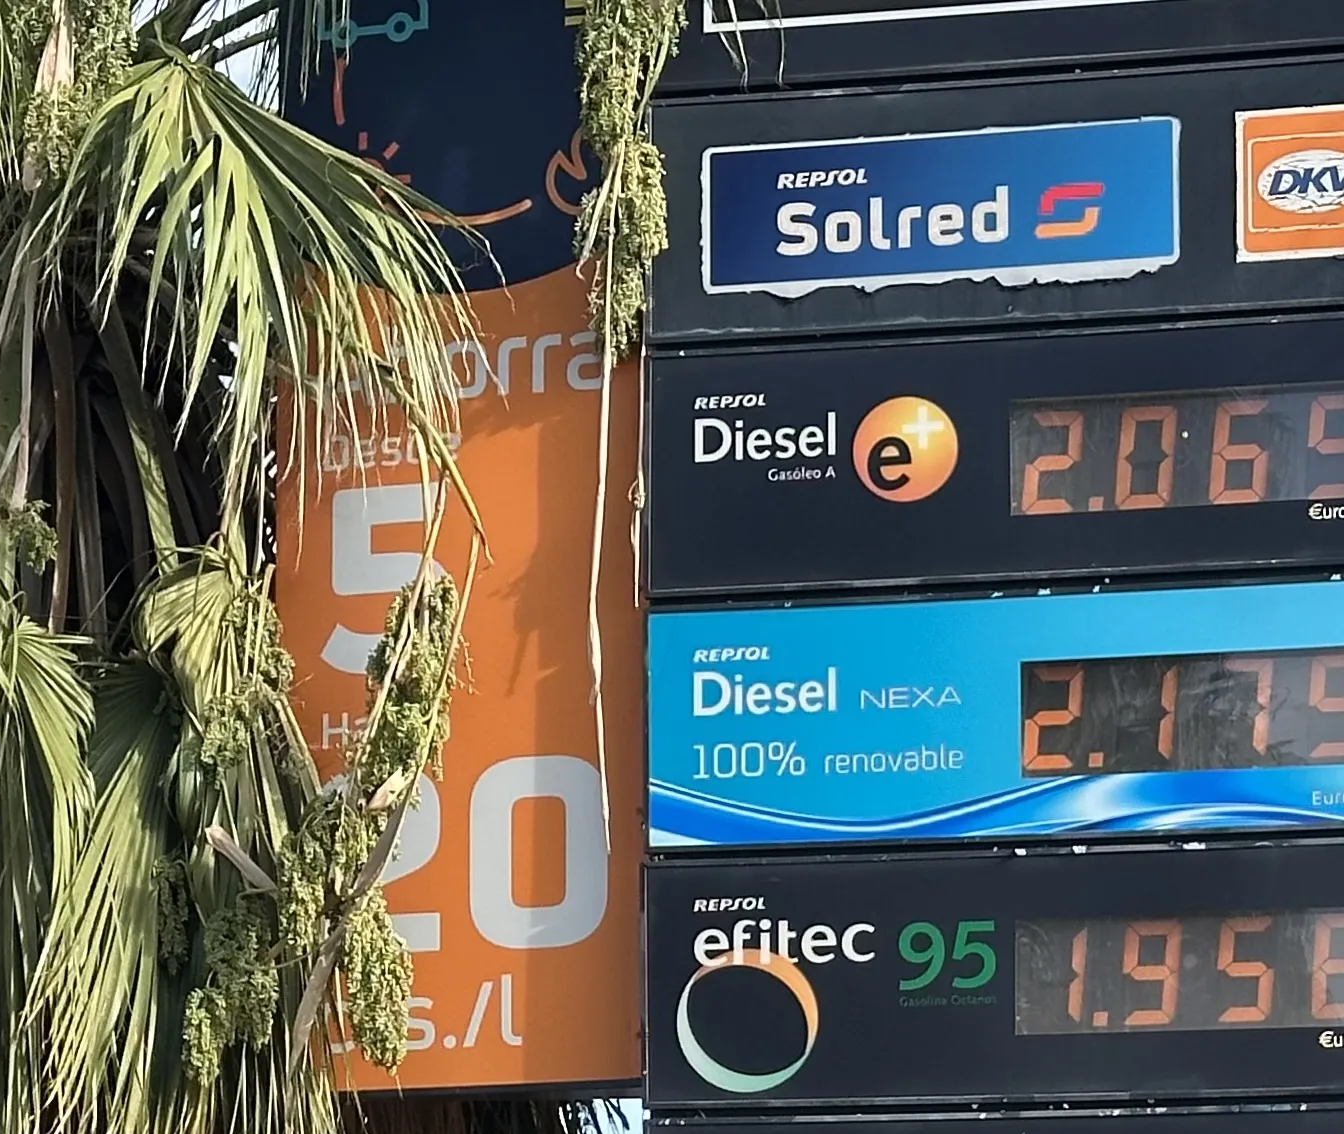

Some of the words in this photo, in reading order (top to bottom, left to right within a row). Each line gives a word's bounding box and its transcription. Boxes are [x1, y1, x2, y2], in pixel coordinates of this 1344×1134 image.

[777, 168, 868, 189] REPSOL
[775, 185, 1009, 257] Solred
[693, 394, 767, 410] REPSOL
[693, 413, 836, 464] Diesel
[767, 466, 821, 482] Gasóleo
[825, 465, 836, 479] A
[693, 646, 771, 663] REPSOL
[691, 666, 838, 719] Diesel
[860, 686, 961, 709] NEXA
[692, 743, 806, 780] 100%
[824, 745, 963, 776] renovable
[693, 896, 765, 911] REPSOL
[693, 918, 875, 969] efitec
[898, 920, 998, 991] 95
